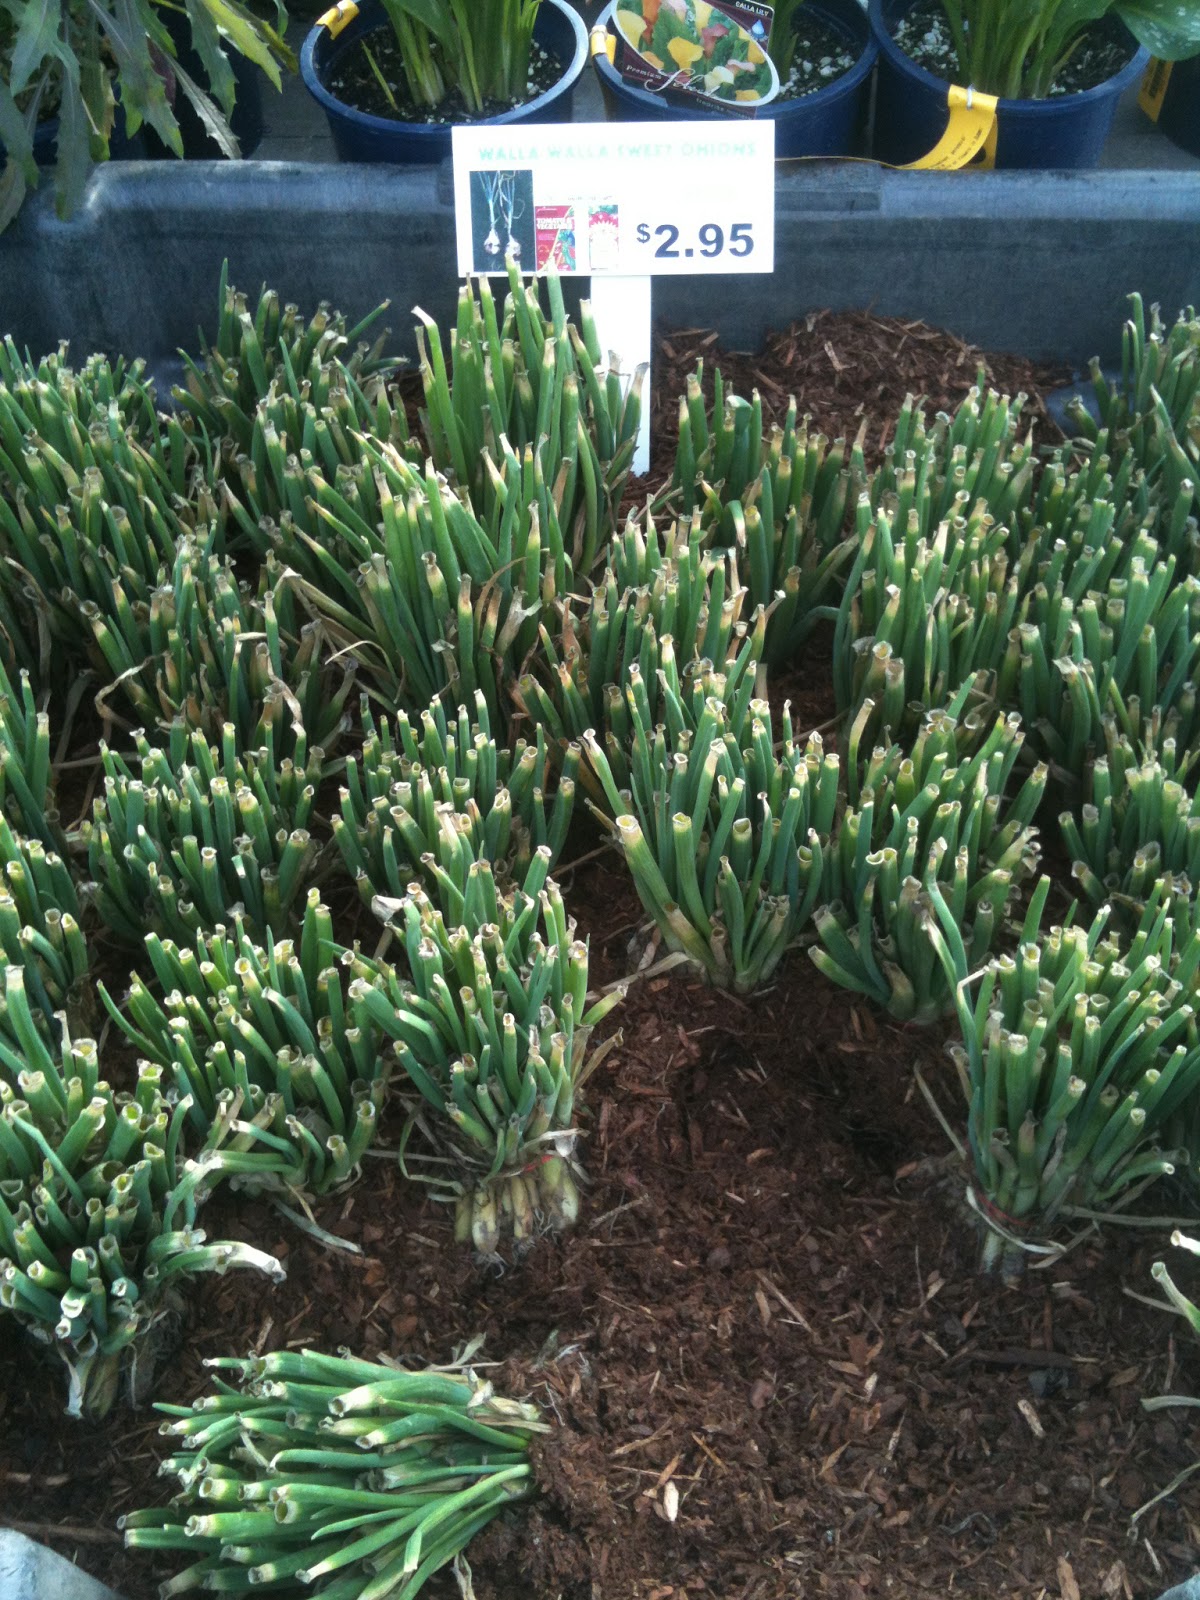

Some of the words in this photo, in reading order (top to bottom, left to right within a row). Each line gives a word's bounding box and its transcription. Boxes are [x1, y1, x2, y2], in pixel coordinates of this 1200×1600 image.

[625, 64, 662, 80] Premium
[479, 146, 539, 161] WALLA
[547, 145, 608, 160] WALLA
[618, 144, 673, 159] SWEET
[681, 141, 757, 158] ONIONS
[636, 223, 755, 258] $2.95
